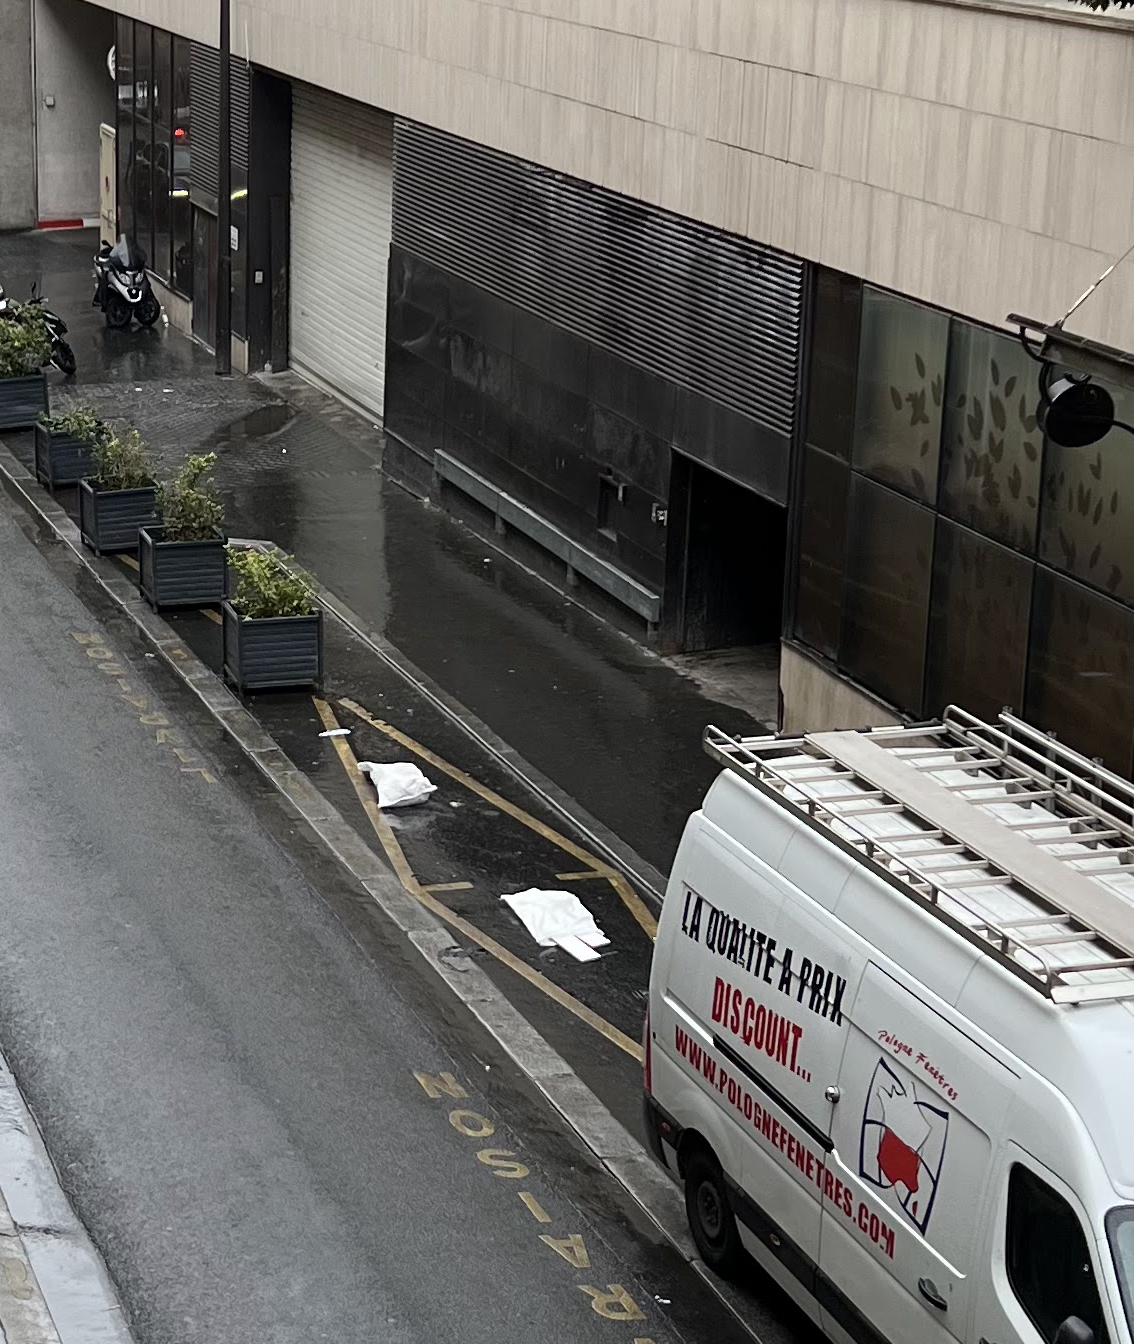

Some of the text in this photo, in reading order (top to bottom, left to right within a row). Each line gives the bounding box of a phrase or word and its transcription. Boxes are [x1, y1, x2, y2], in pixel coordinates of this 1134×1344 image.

[681, 891, 847, 1027] LA QUALITE A PRIX
[878, 1030, 914, 1057] Pologne
[674, 1025, 896, 1260] WWW.POLOGNEFENETRES.COM
